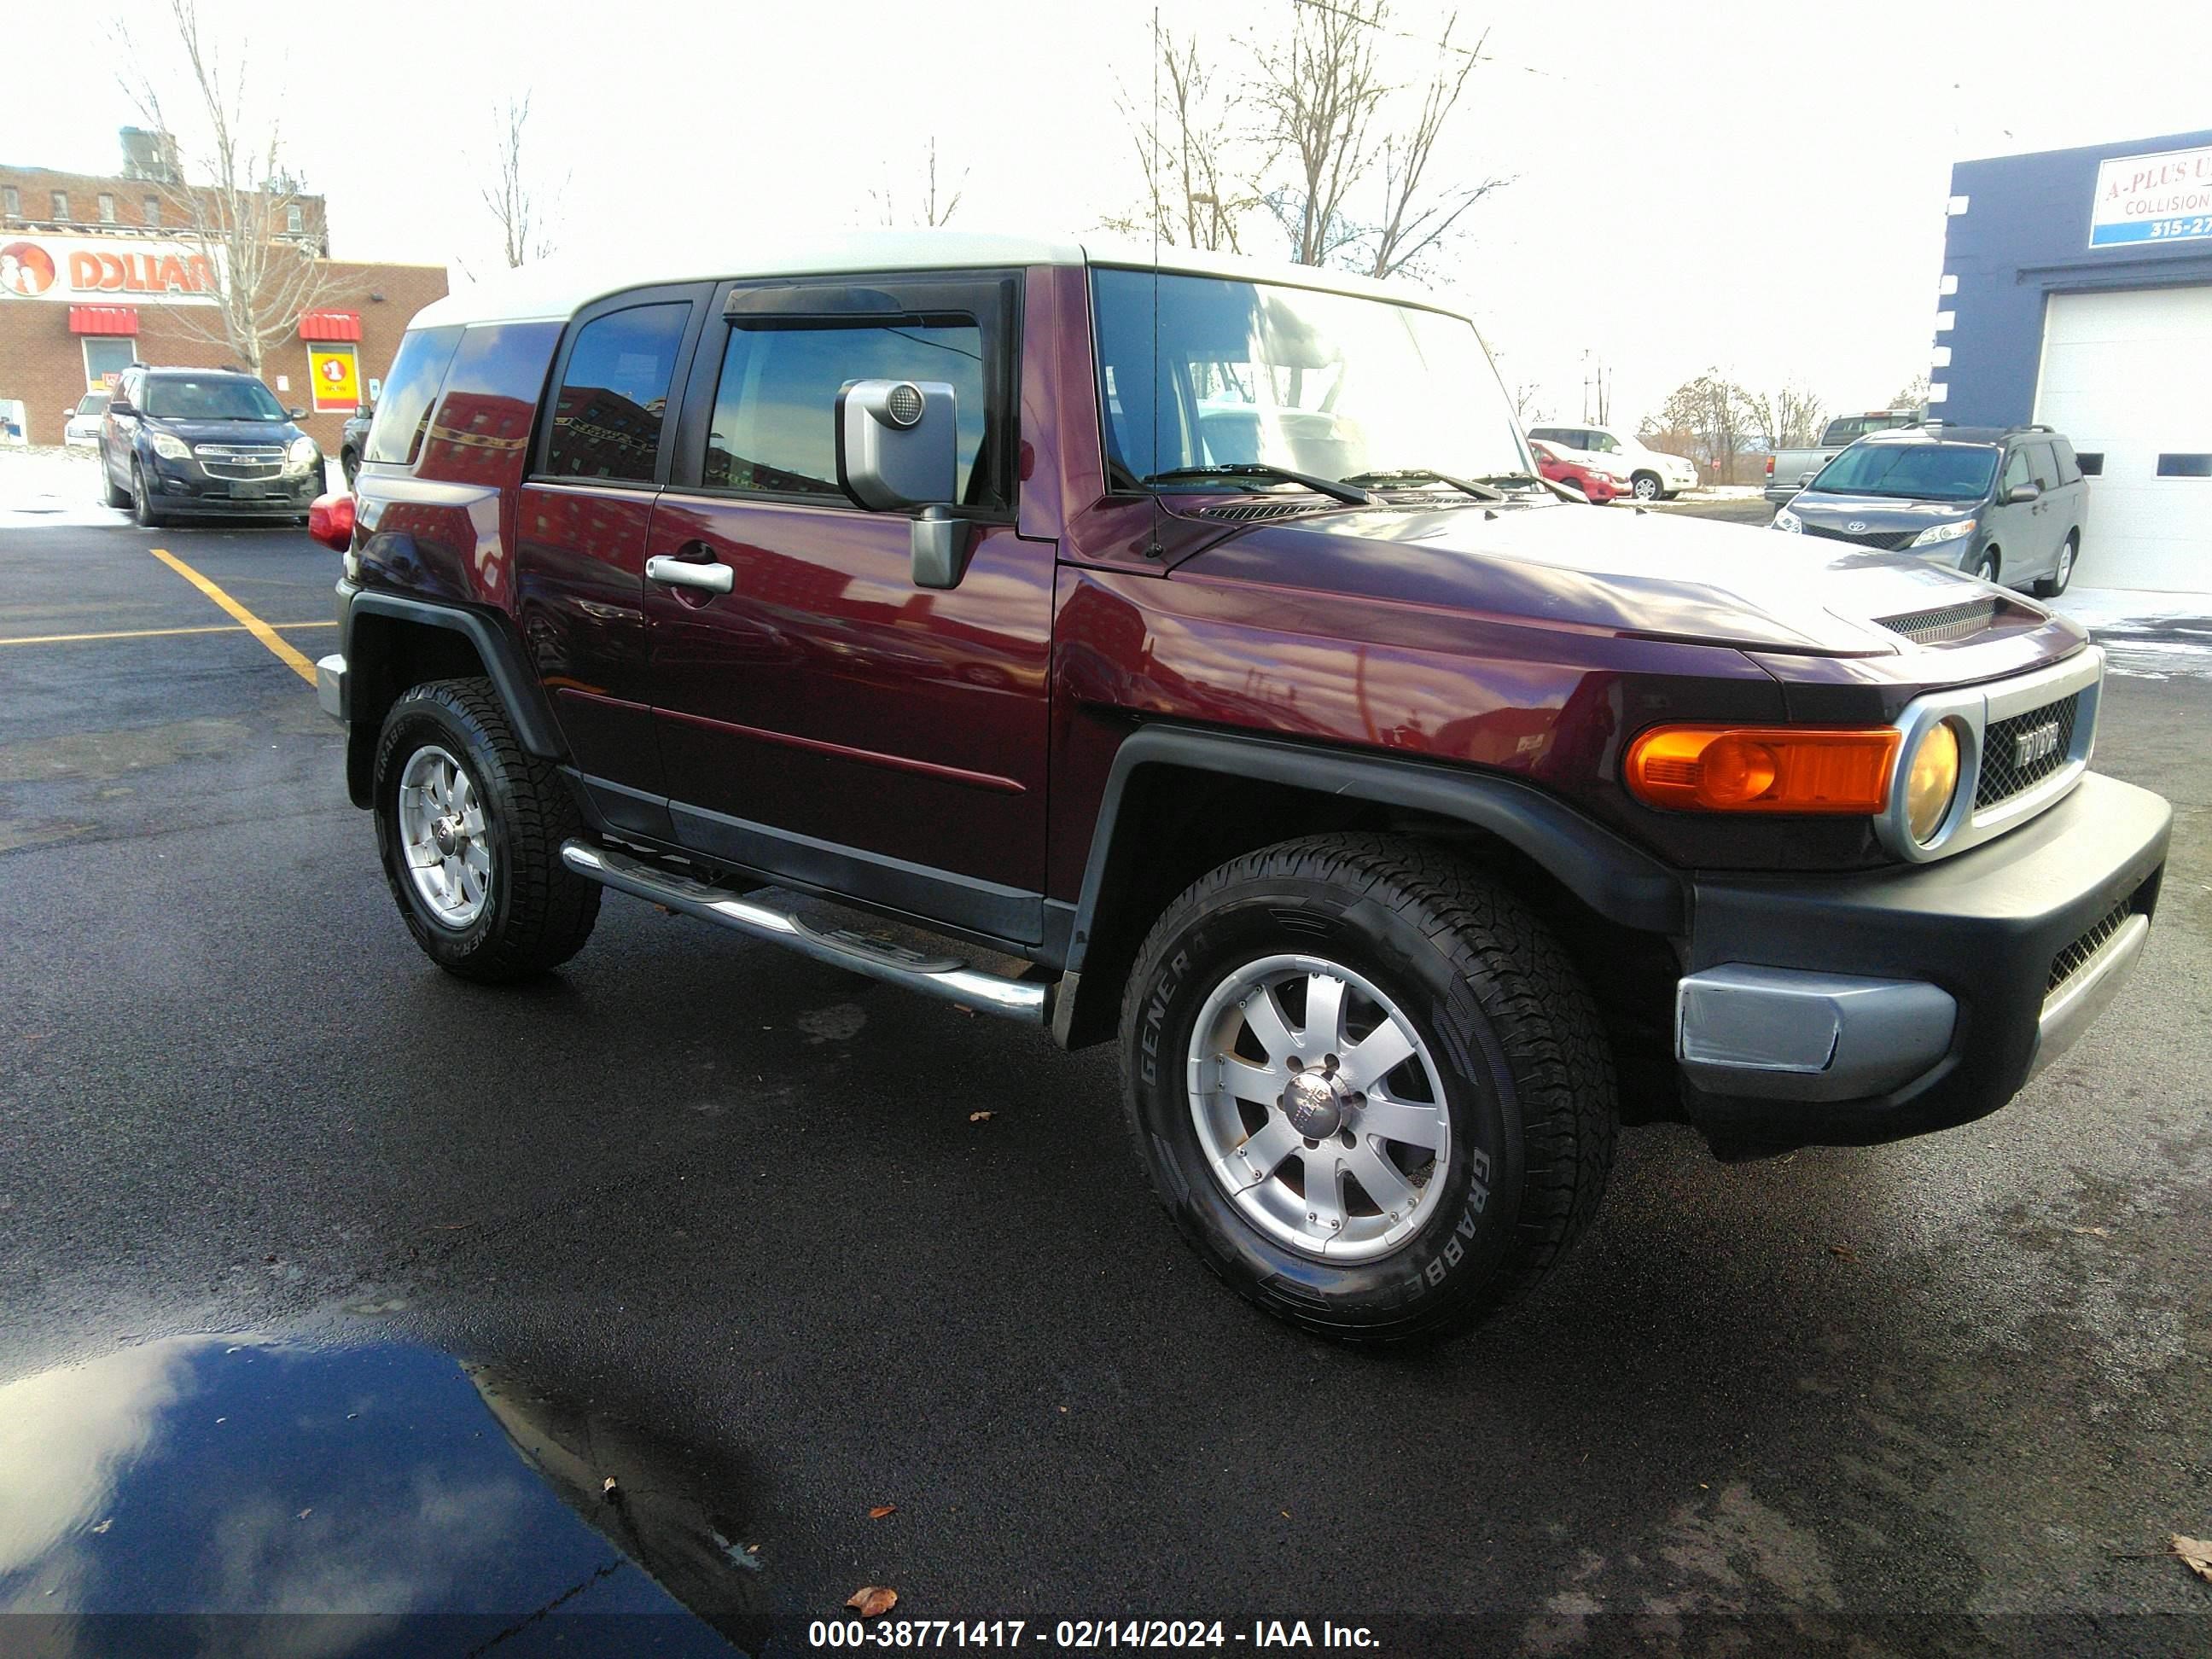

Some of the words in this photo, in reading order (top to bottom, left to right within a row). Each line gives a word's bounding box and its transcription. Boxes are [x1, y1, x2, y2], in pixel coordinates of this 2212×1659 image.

[2105, 161, 2187, 201] A-PLUS
[2126, 193, 2210, 216] COLLISION
[68, 251, 219, 294] DOLLAR
